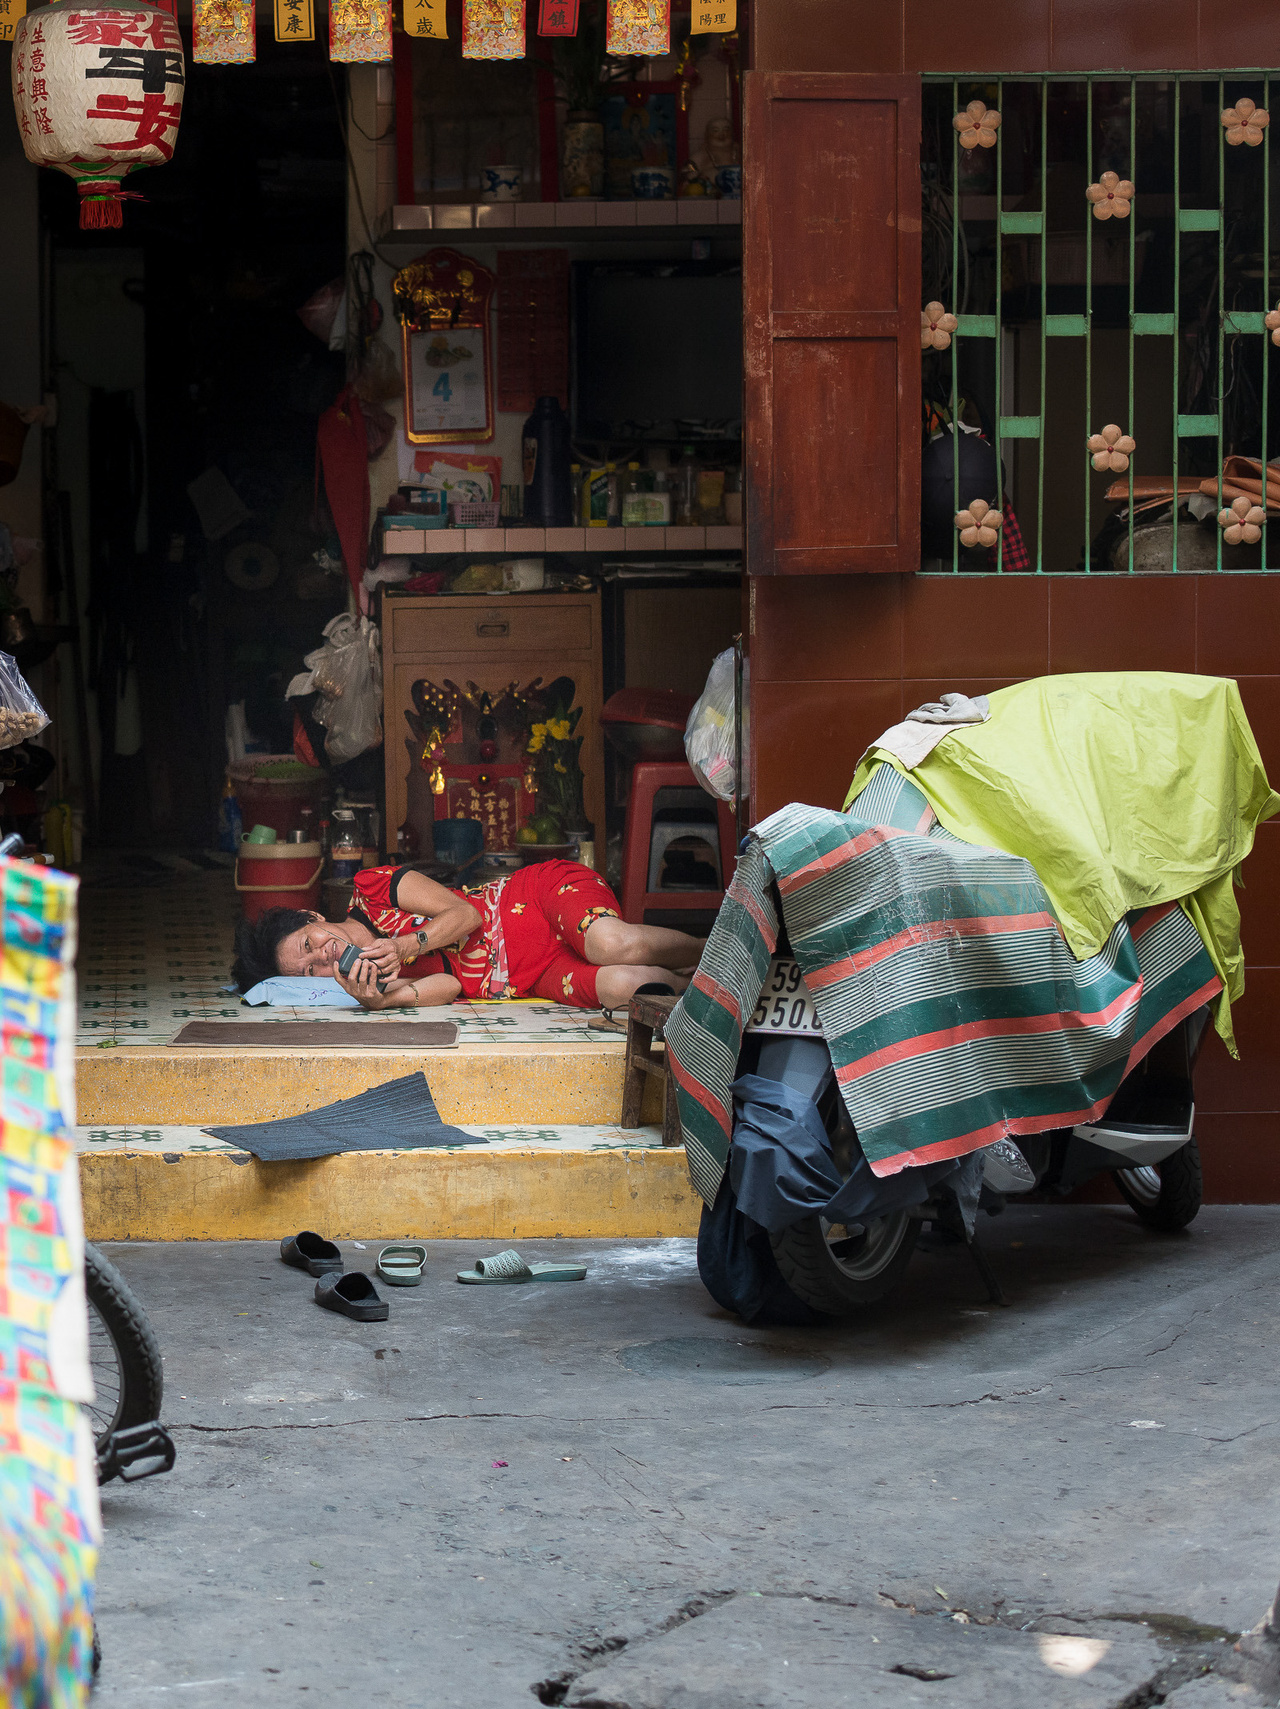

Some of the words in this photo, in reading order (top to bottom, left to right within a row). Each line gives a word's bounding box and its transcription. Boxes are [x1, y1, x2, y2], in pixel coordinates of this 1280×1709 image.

[29, 21, 55, 136] 生意興隆
[433, 372, 453, 402] 4
[771, 962, 801, 993] 59
